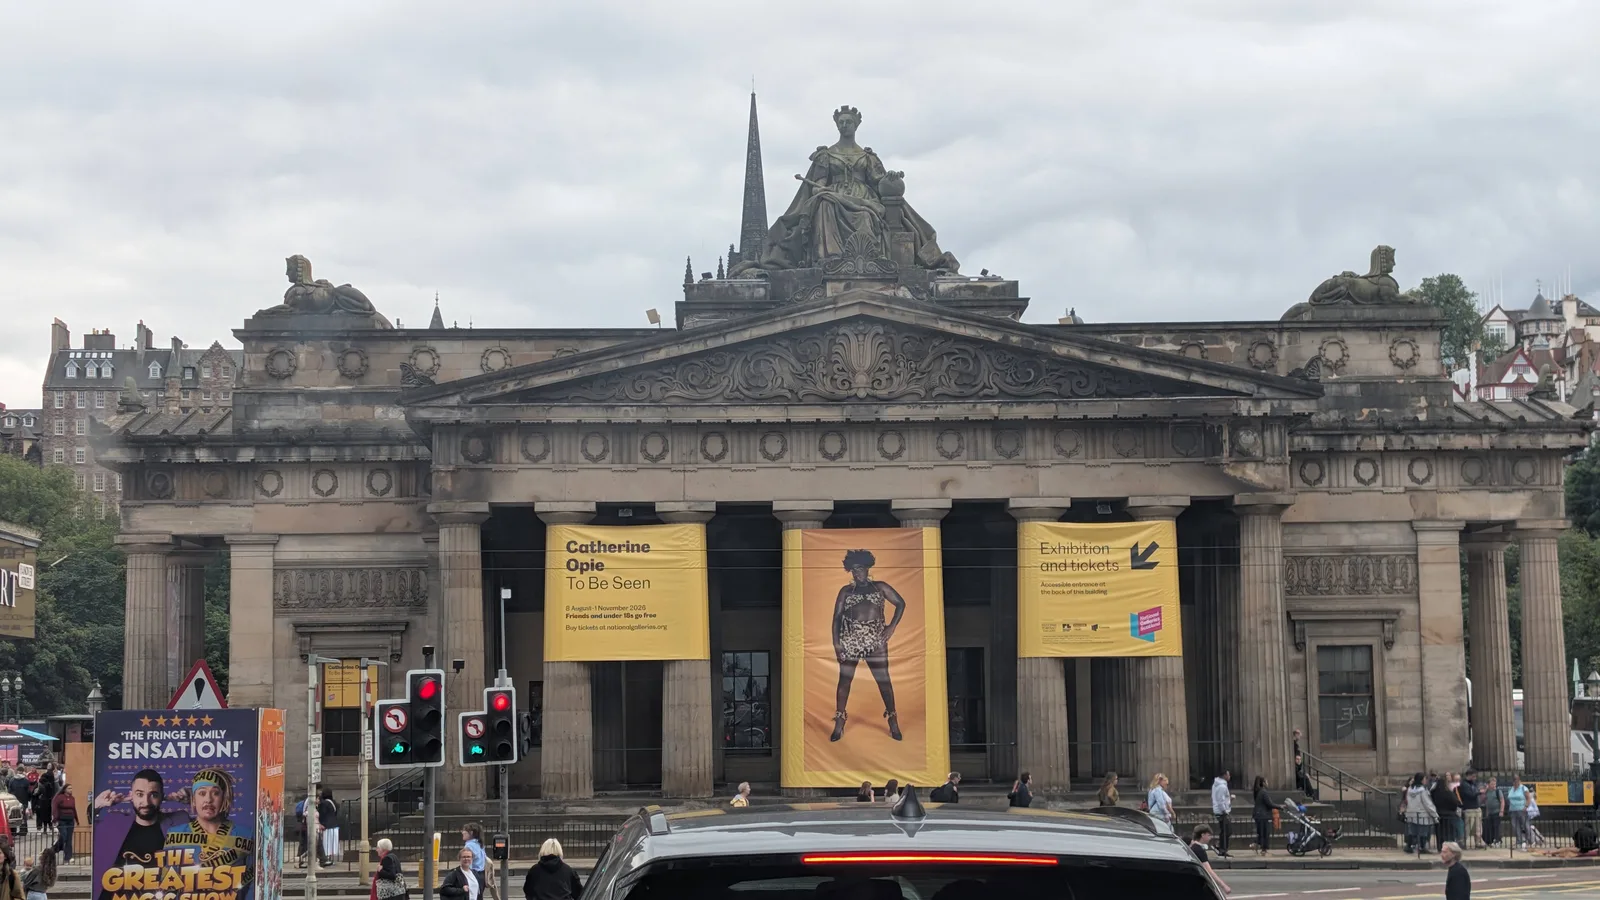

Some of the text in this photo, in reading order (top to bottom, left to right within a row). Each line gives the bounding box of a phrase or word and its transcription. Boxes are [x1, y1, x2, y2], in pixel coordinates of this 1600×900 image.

[566, 540, 651, 554] Catherine
[1040, 542, 1110, 555] Exhibition
[566, 558, 605, 575] Opie
[1040, 559, 1120, 572] and tickets
[566, 576, 651, 590] To Be Seen
[1085, 589, 1108, 597] building
[147, 730, 186, 739] FRINGE
[189, 730, 226, 739] FAMILY
[166, 833, 208, 845] CAUTION
[154, 848, 195, 867] THE
[101, 864, 246, 891] GREATEST
